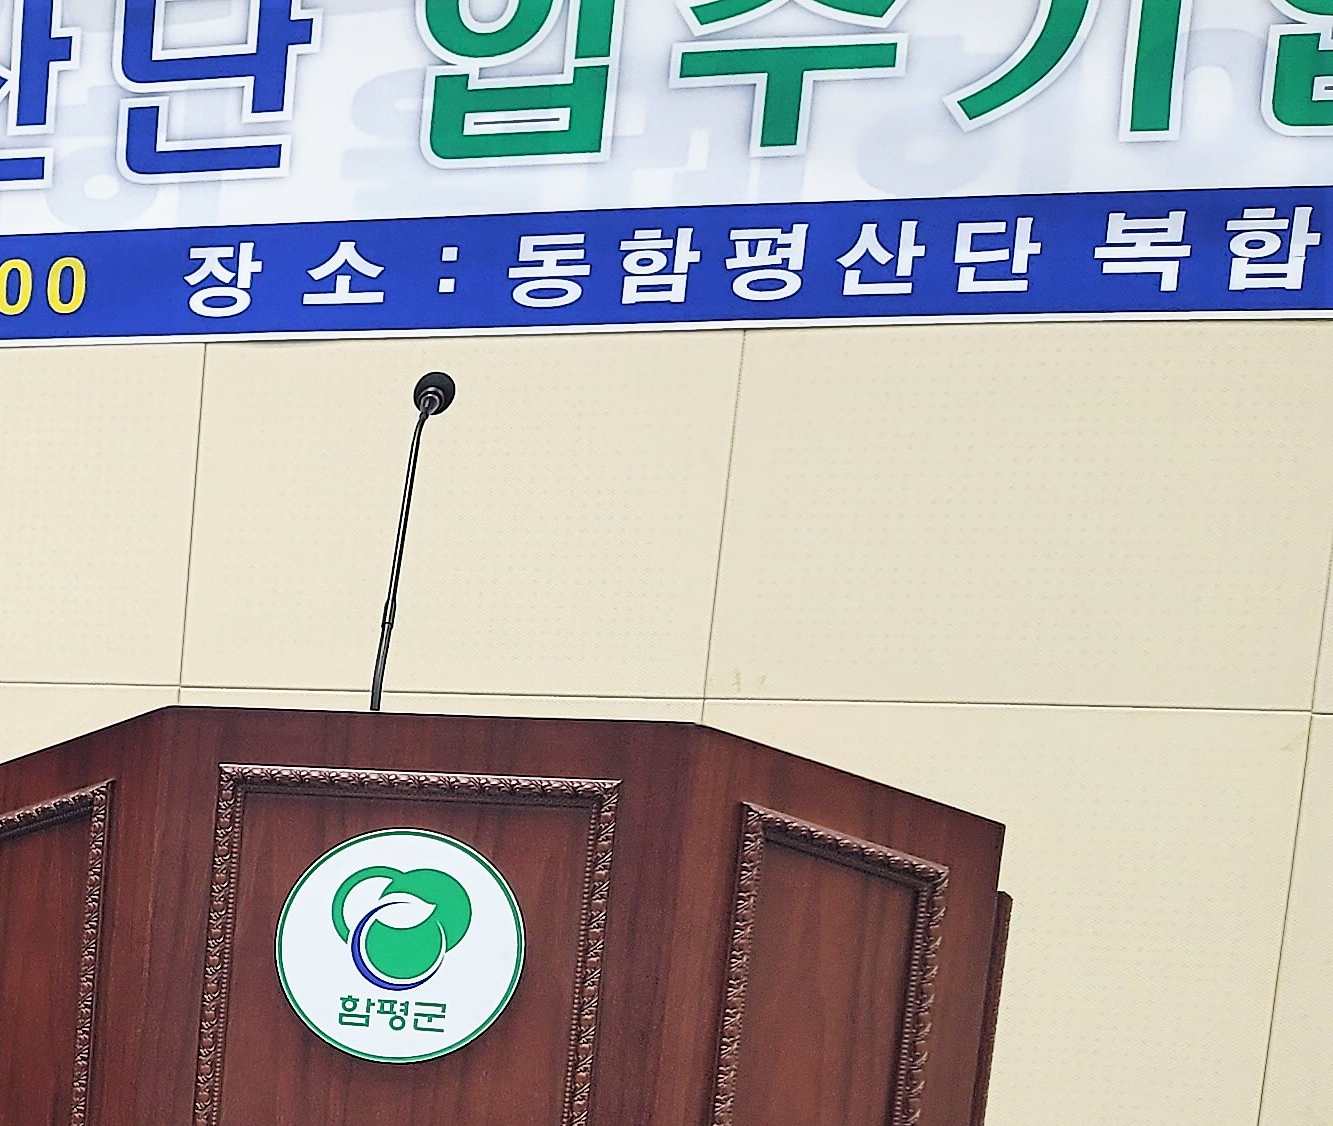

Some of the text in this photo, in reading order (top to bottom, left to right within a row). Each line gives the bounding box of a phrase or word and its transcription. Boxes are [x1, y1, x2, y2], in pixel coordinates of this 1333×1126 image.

[425, 0, 1333, 160] 입주기
[507, 217, 1042, 308] 동함평산단
[1093, 206, 1321, 292] 복합
[339, 995, 447, 1033] 함평군
